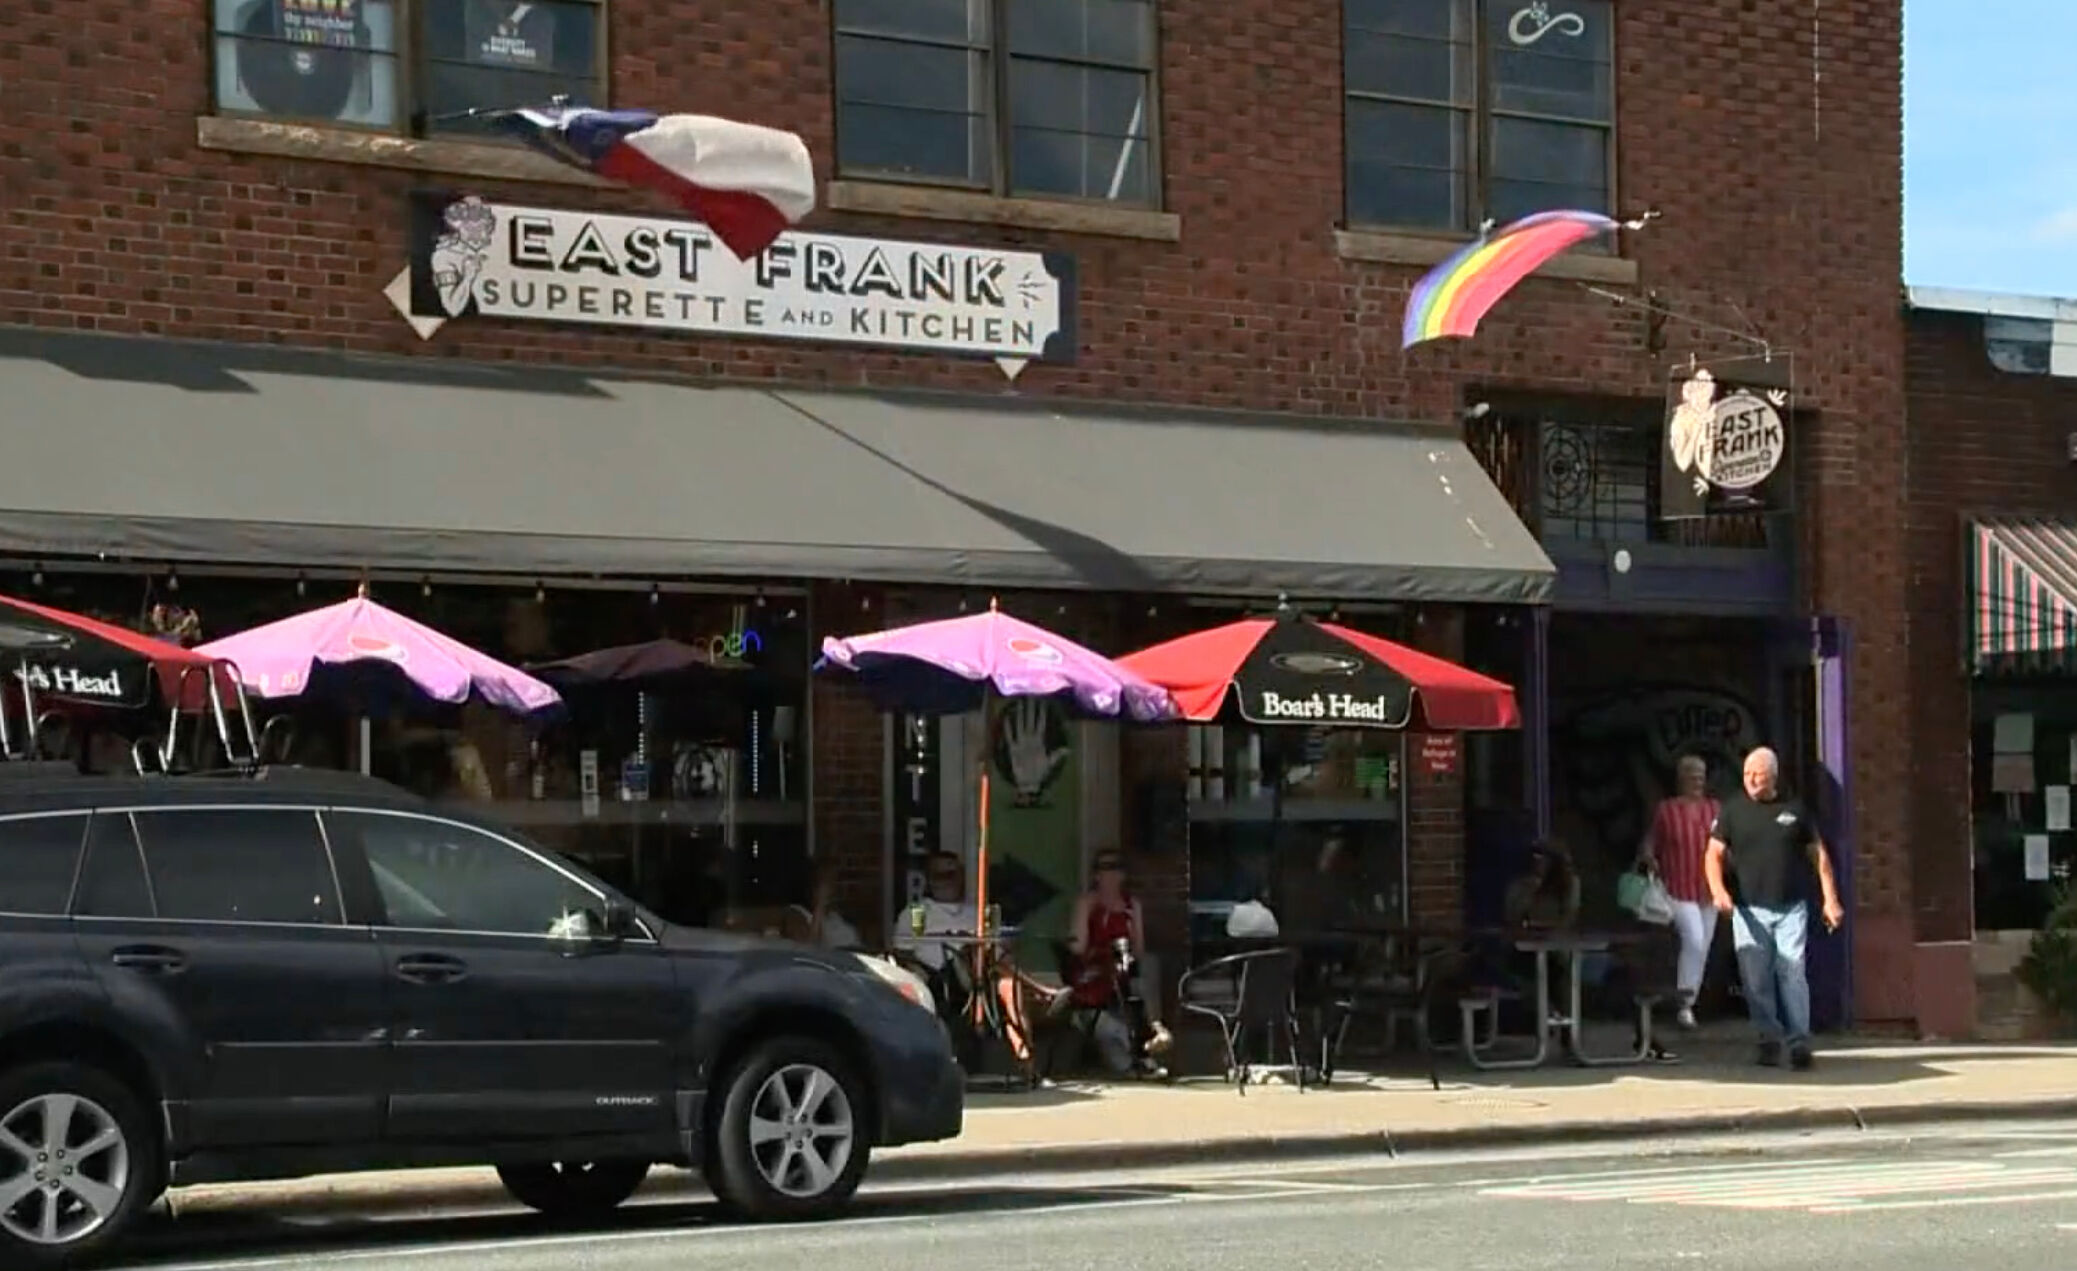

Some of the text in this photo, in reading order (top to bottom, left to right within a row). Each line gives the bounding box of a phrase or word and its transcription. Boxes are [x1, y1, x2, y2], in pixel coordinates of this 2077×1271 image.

[509, 215, 1007, 307] EAST FRANK
[482, 278, 1034, 346] SUPERETTE AND KITCHEN
[52, 664, 122, 697] Head
[1262, 691, 1385, 721] Boar's Head
[902, 712, 929, 904] NTER
[596, 1096, 656, 1106] OUTBACK
